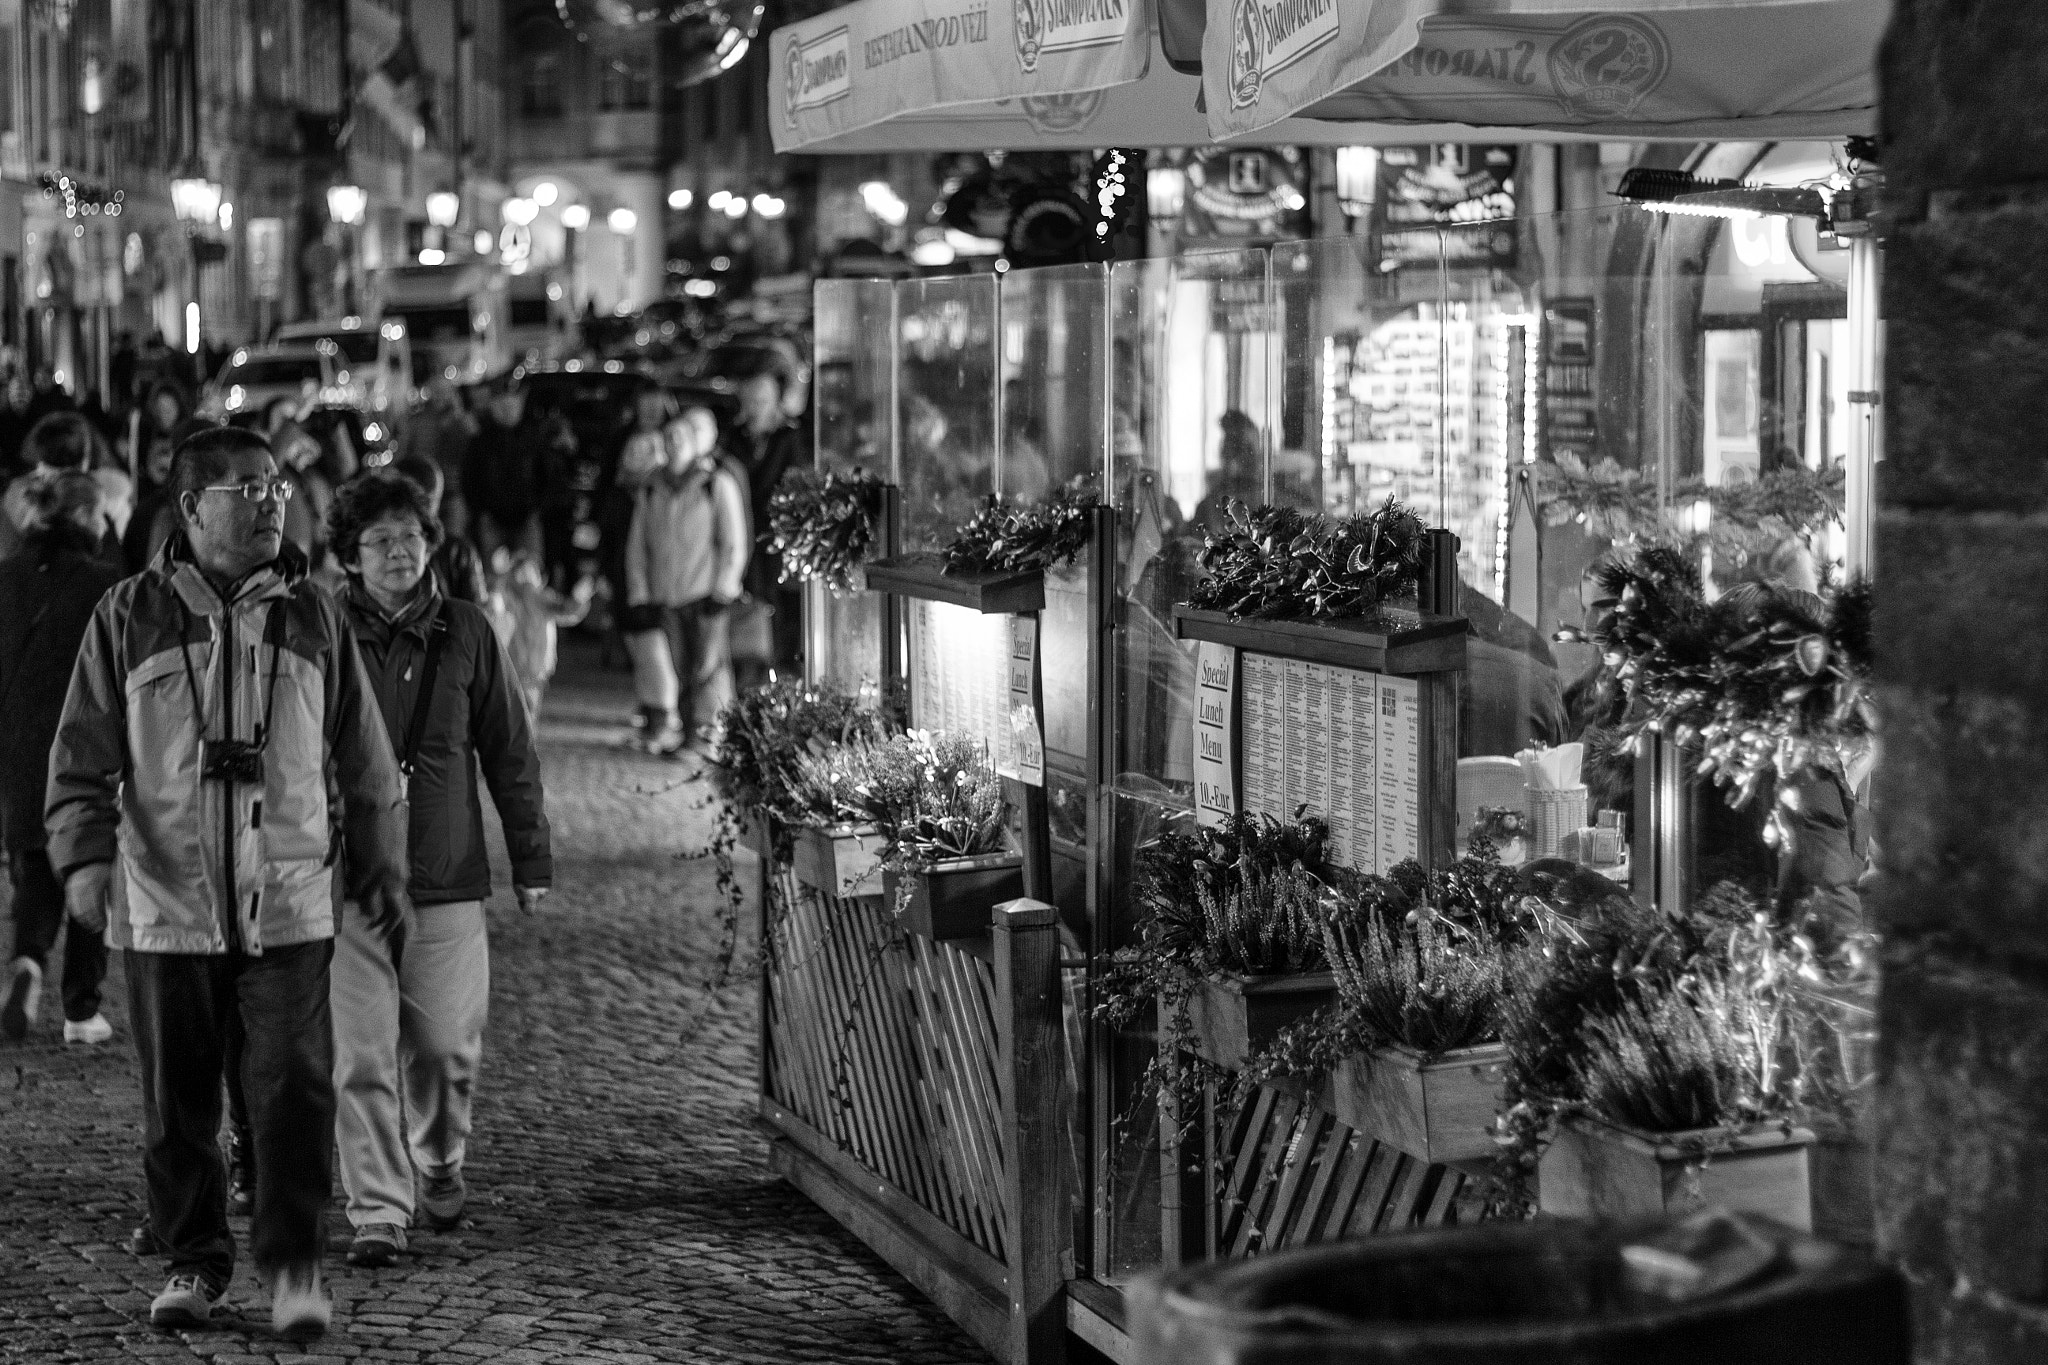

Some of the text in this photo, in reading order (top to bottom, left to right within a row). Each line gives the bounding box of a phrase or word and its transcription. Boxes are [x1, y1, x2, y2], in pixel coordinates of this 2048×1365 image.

[1261, 0, 1332, 55] STAROPRAM
[1011, 666, 1028, 690] Lunch
[1201, 659, 1230, 687] Special
[1199, 696, 1224, 724] Lunch
[1200, 731, 1223, 759] Menu
